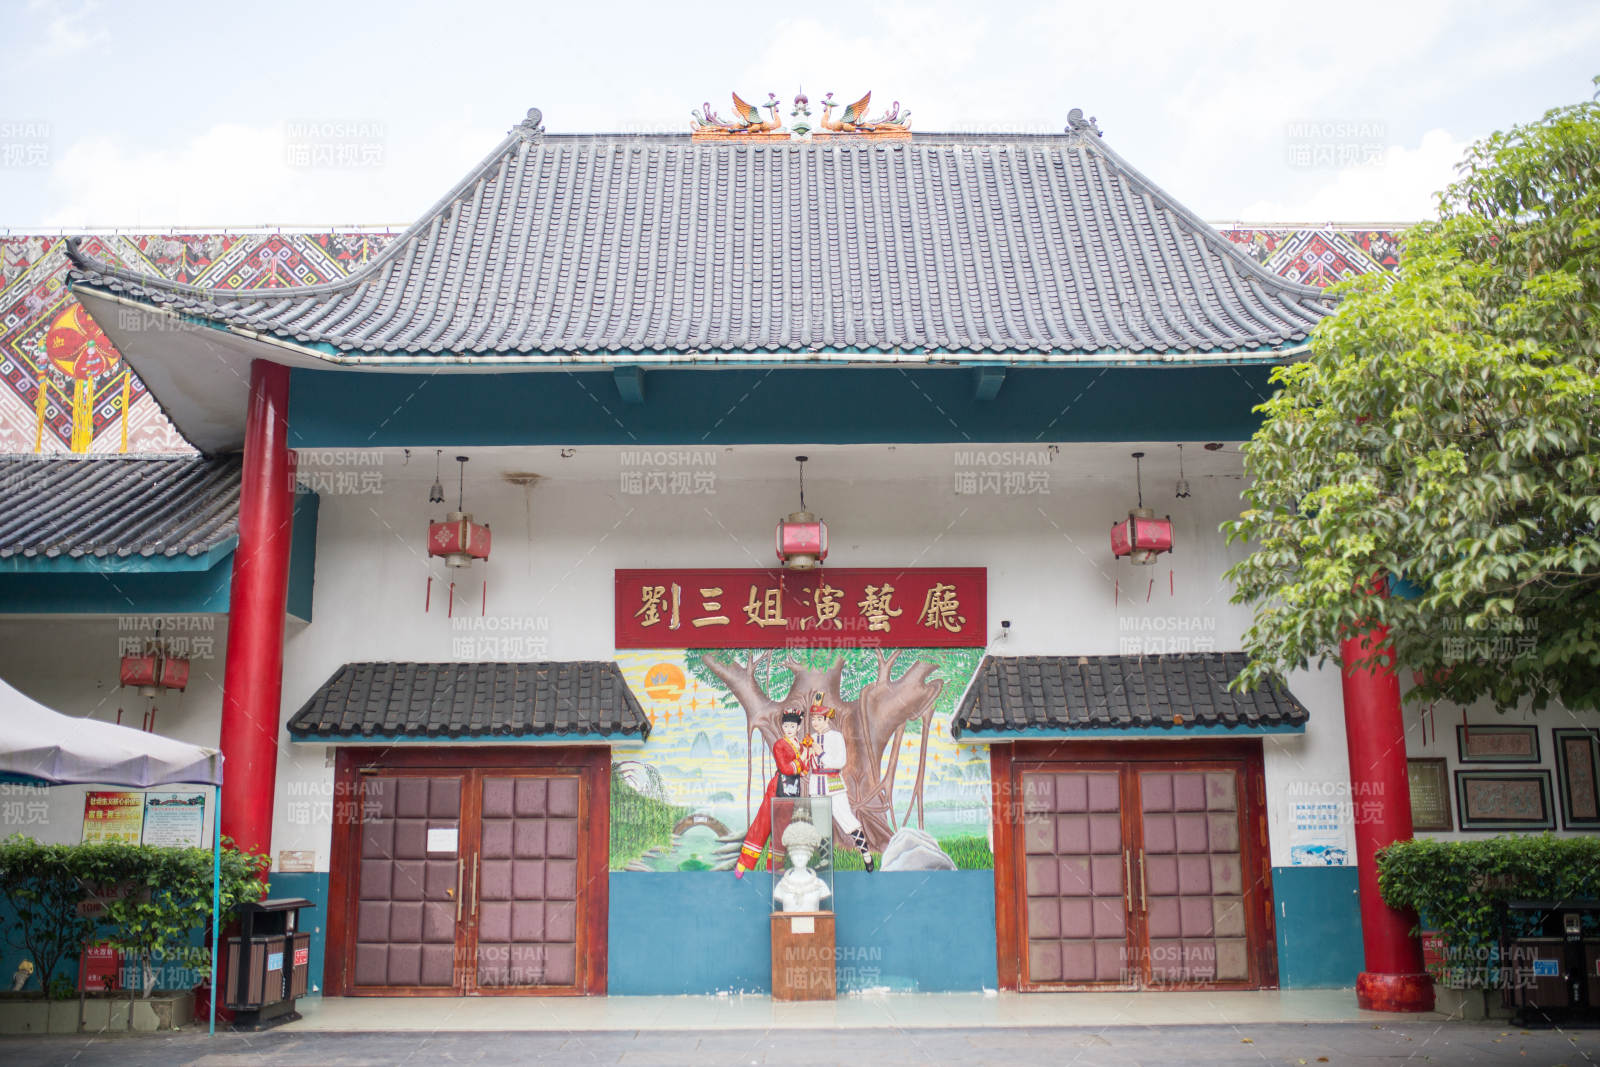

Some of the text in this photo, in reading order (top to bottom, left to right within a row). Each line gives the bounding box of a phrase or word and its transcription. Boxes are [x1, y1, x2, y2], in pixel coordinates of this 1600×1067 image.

[634, 581, 966, 632] 劉三姐演藝廳
